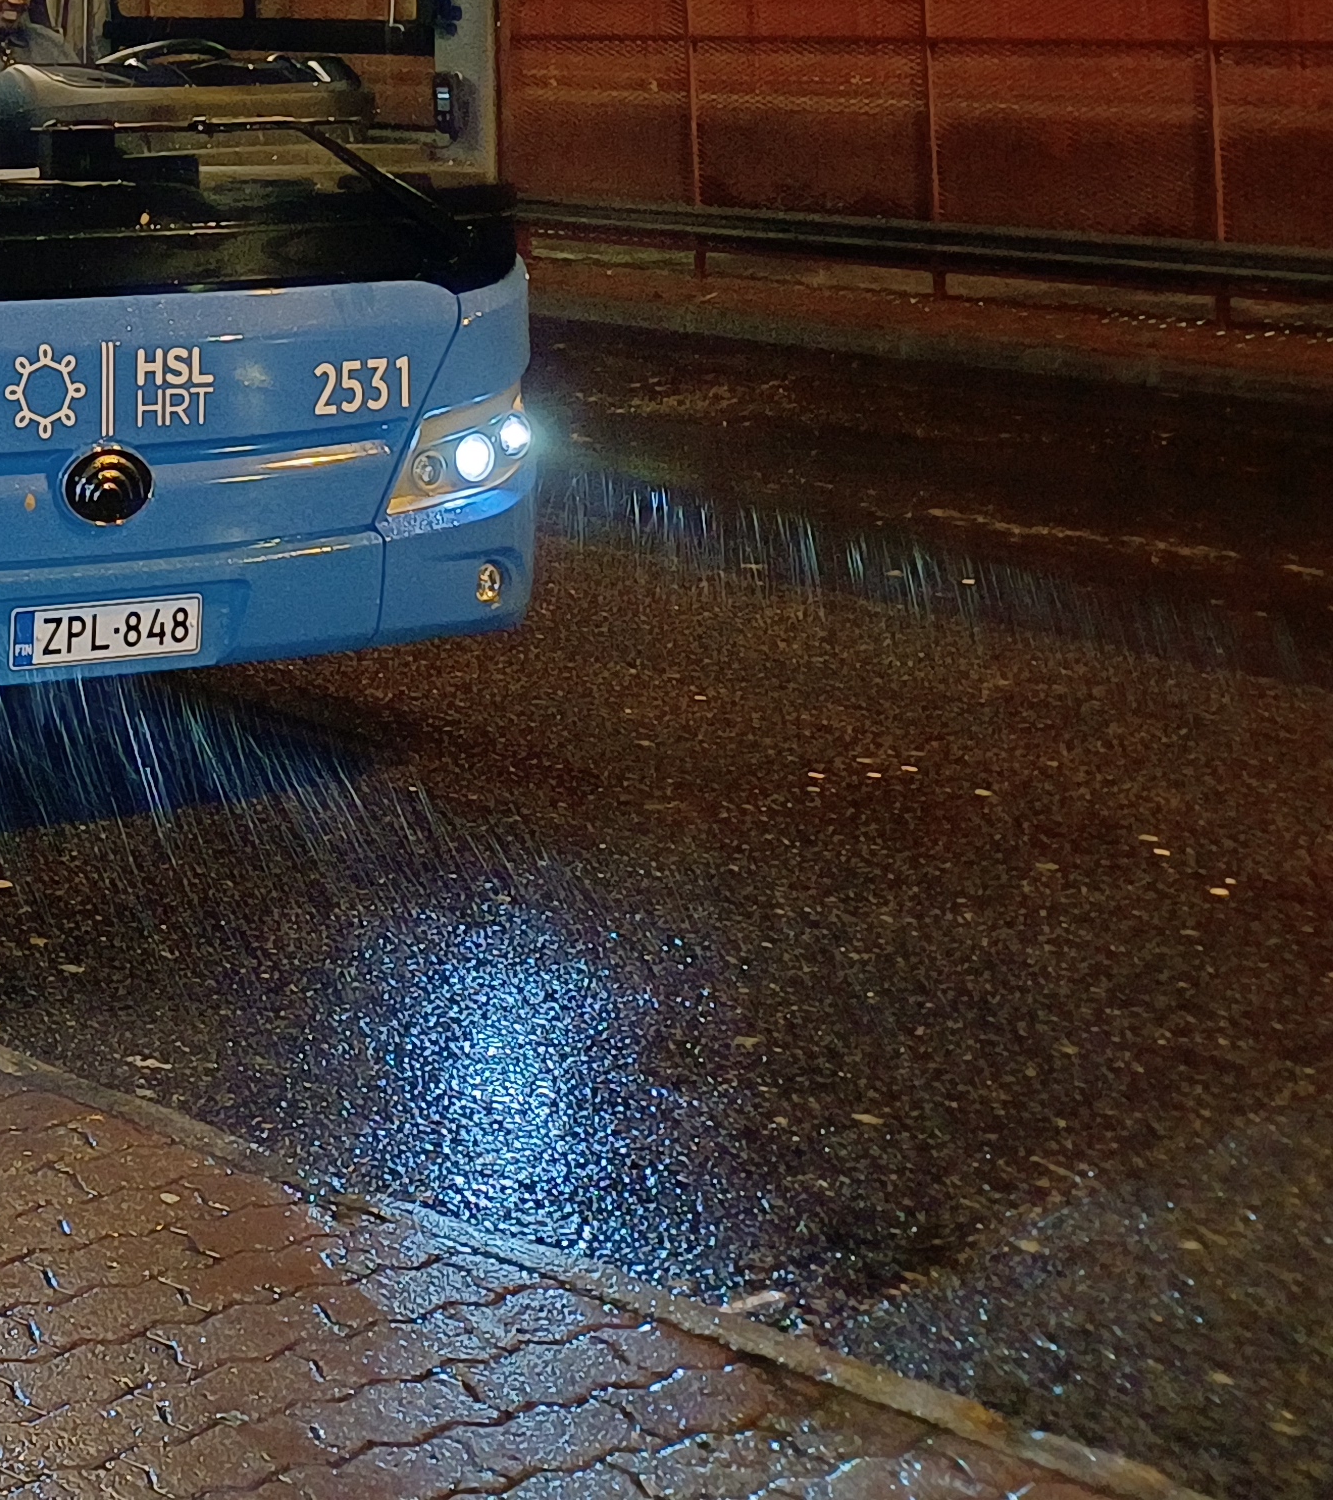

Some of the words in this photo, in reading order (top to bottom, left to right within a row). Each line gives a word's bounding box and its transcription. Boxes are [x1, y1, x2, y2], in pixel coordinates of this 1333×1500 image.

[135, 346, 215, 387] HSL
[312, 354, 412, 416] 2531
[136, 386, 215, 428] HRT
[14, 643, 33, 657] FIN
[41, 605, 191, 657] ZPL-848
